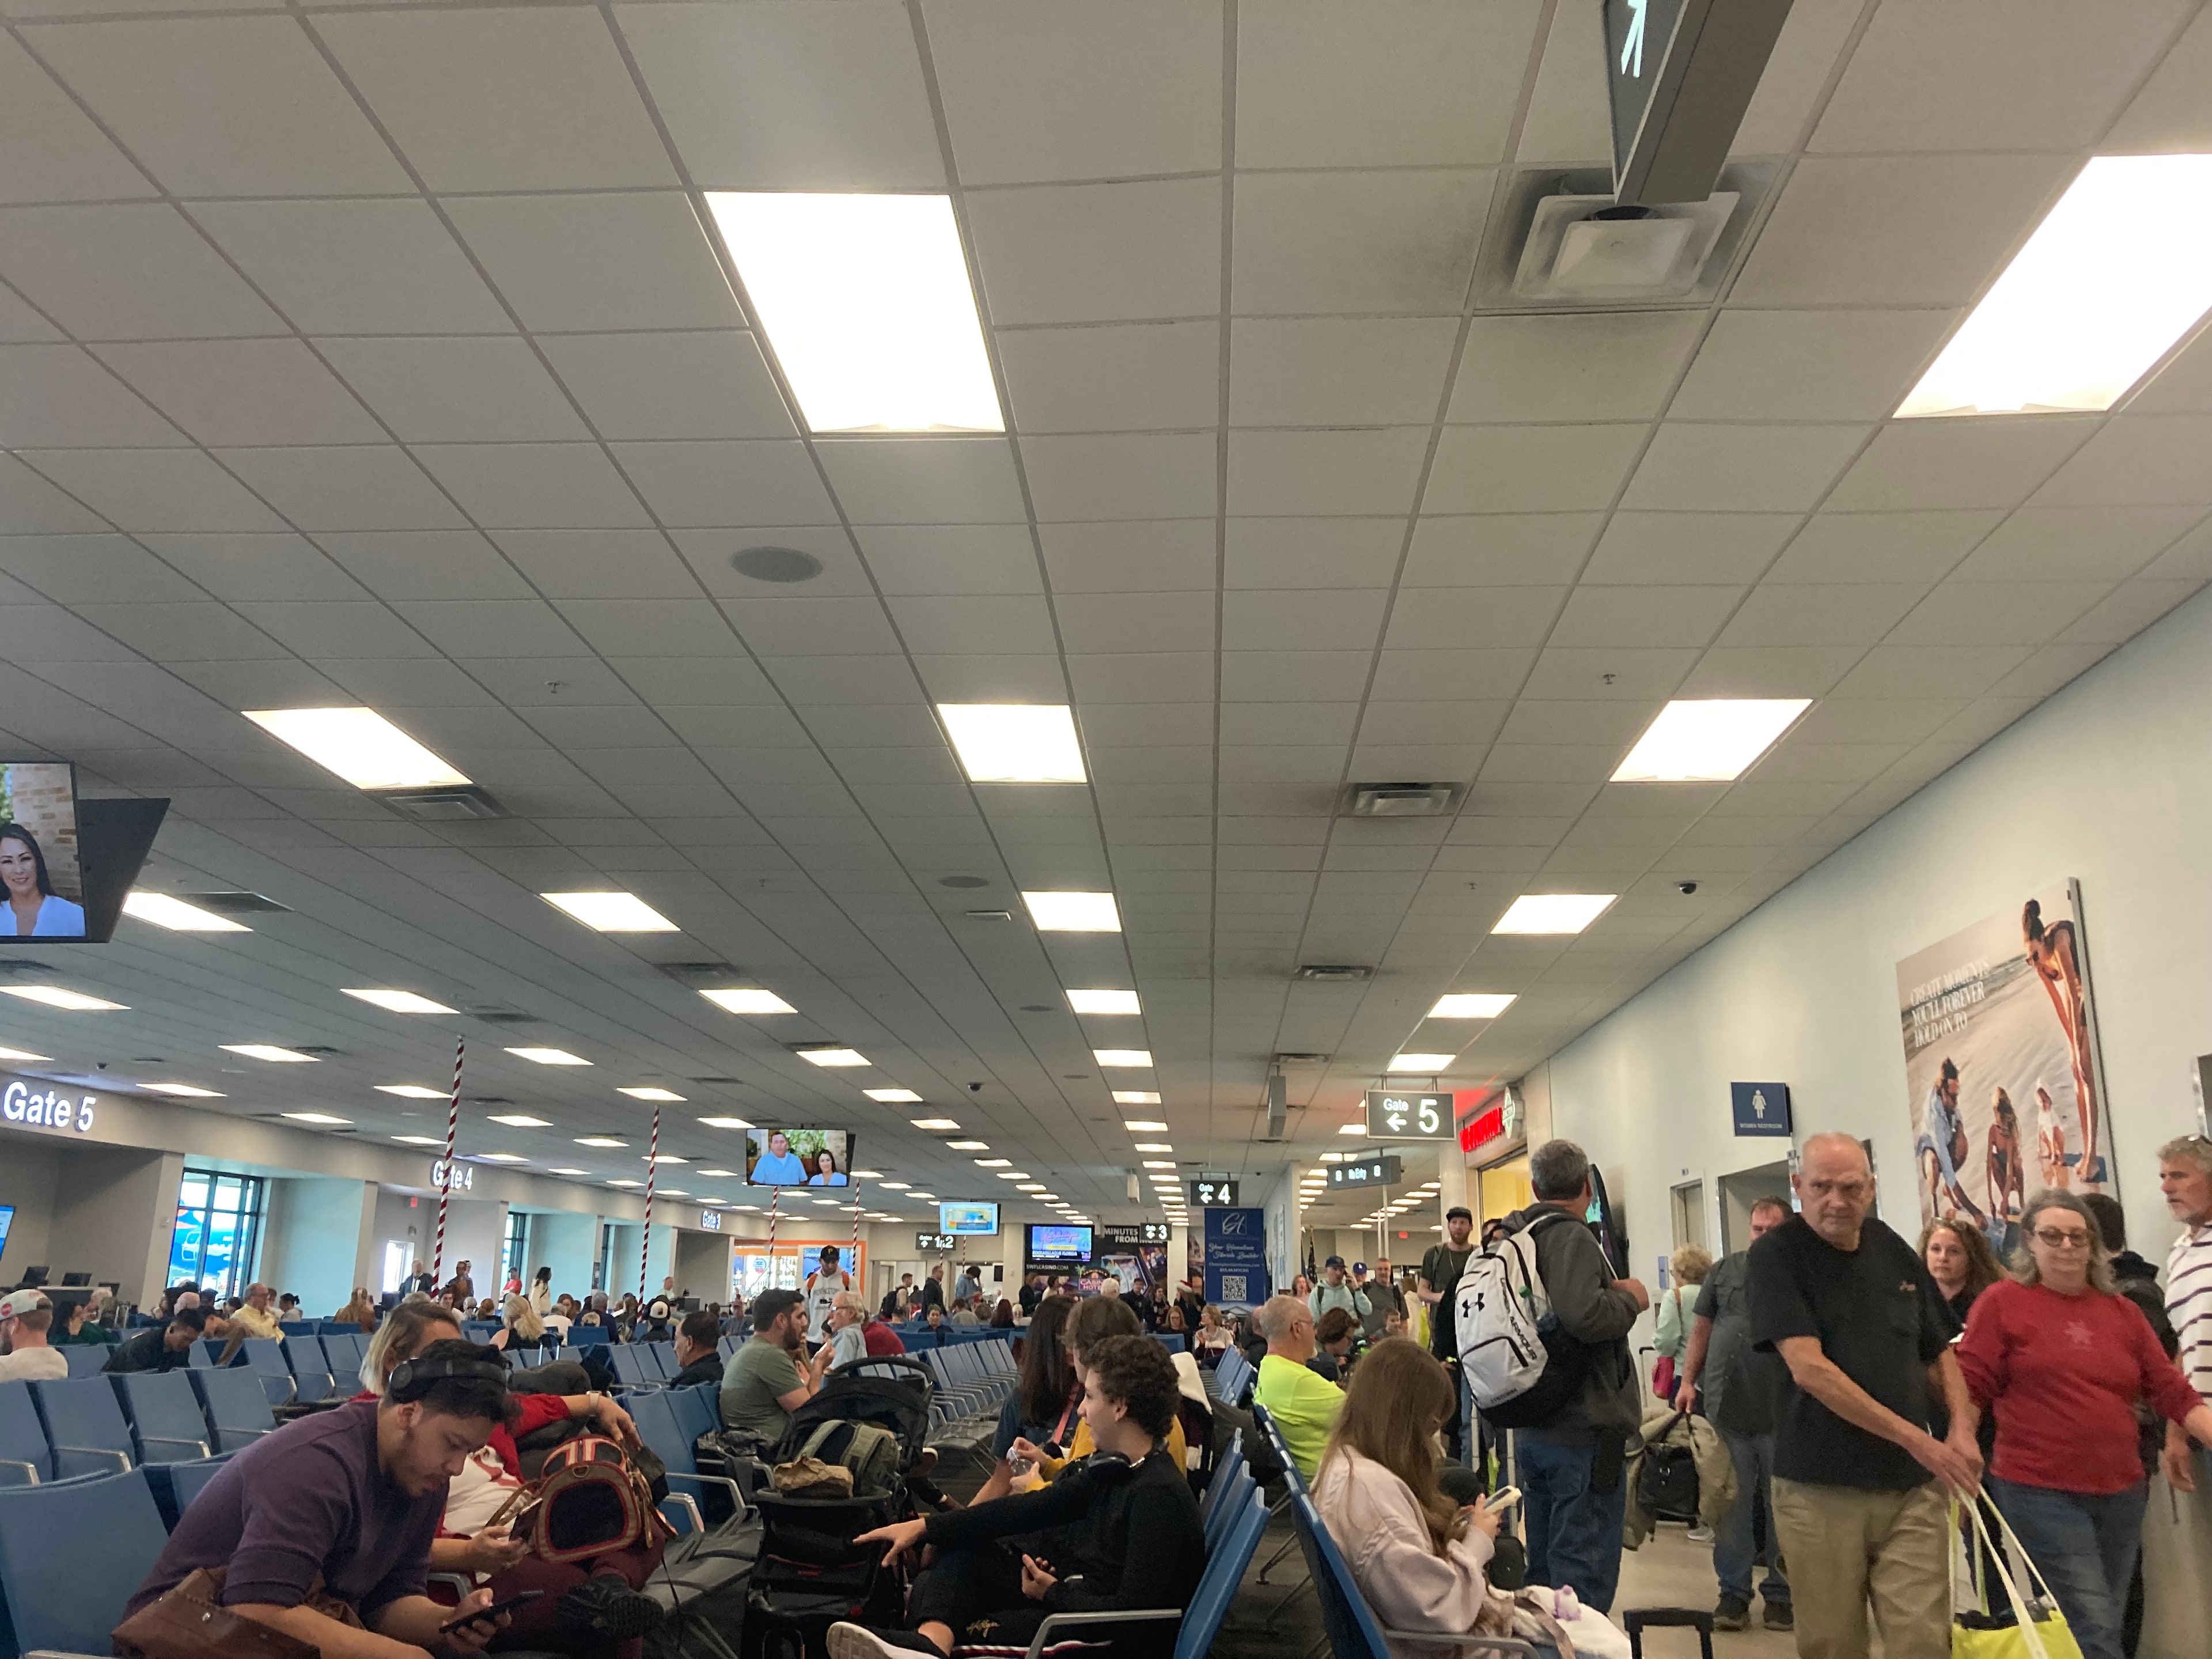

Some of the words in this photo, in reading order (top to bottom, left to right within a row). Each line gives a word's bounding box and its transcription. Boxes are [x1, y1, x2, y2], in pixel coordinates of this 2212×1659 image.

[1942, 981, 1985, 1014] FOREVER
[3, 1081, 71, 1127] Gate
[77, 1096, 96, 1131] 5
[1383, 1098, 1408, 1111] Gate
[1419, 1099, 1439, 1133] 5
[433, 1160, 463, 1190] Gte
[464, 1167, 473, 1190] 4
[1199, 1183, 1214, 1192] Gate
[1218, 1183, 1231, 1205] 4
[702, 1210, 716, 1229] Gate
[716, 1213, 721, 1230] 3
[1104, 1228, 1138, 1236] MINUTES
[1158, 1225, 1167, 1240] 3
[1510, 1316, 1537, 1360] ARMOUR
